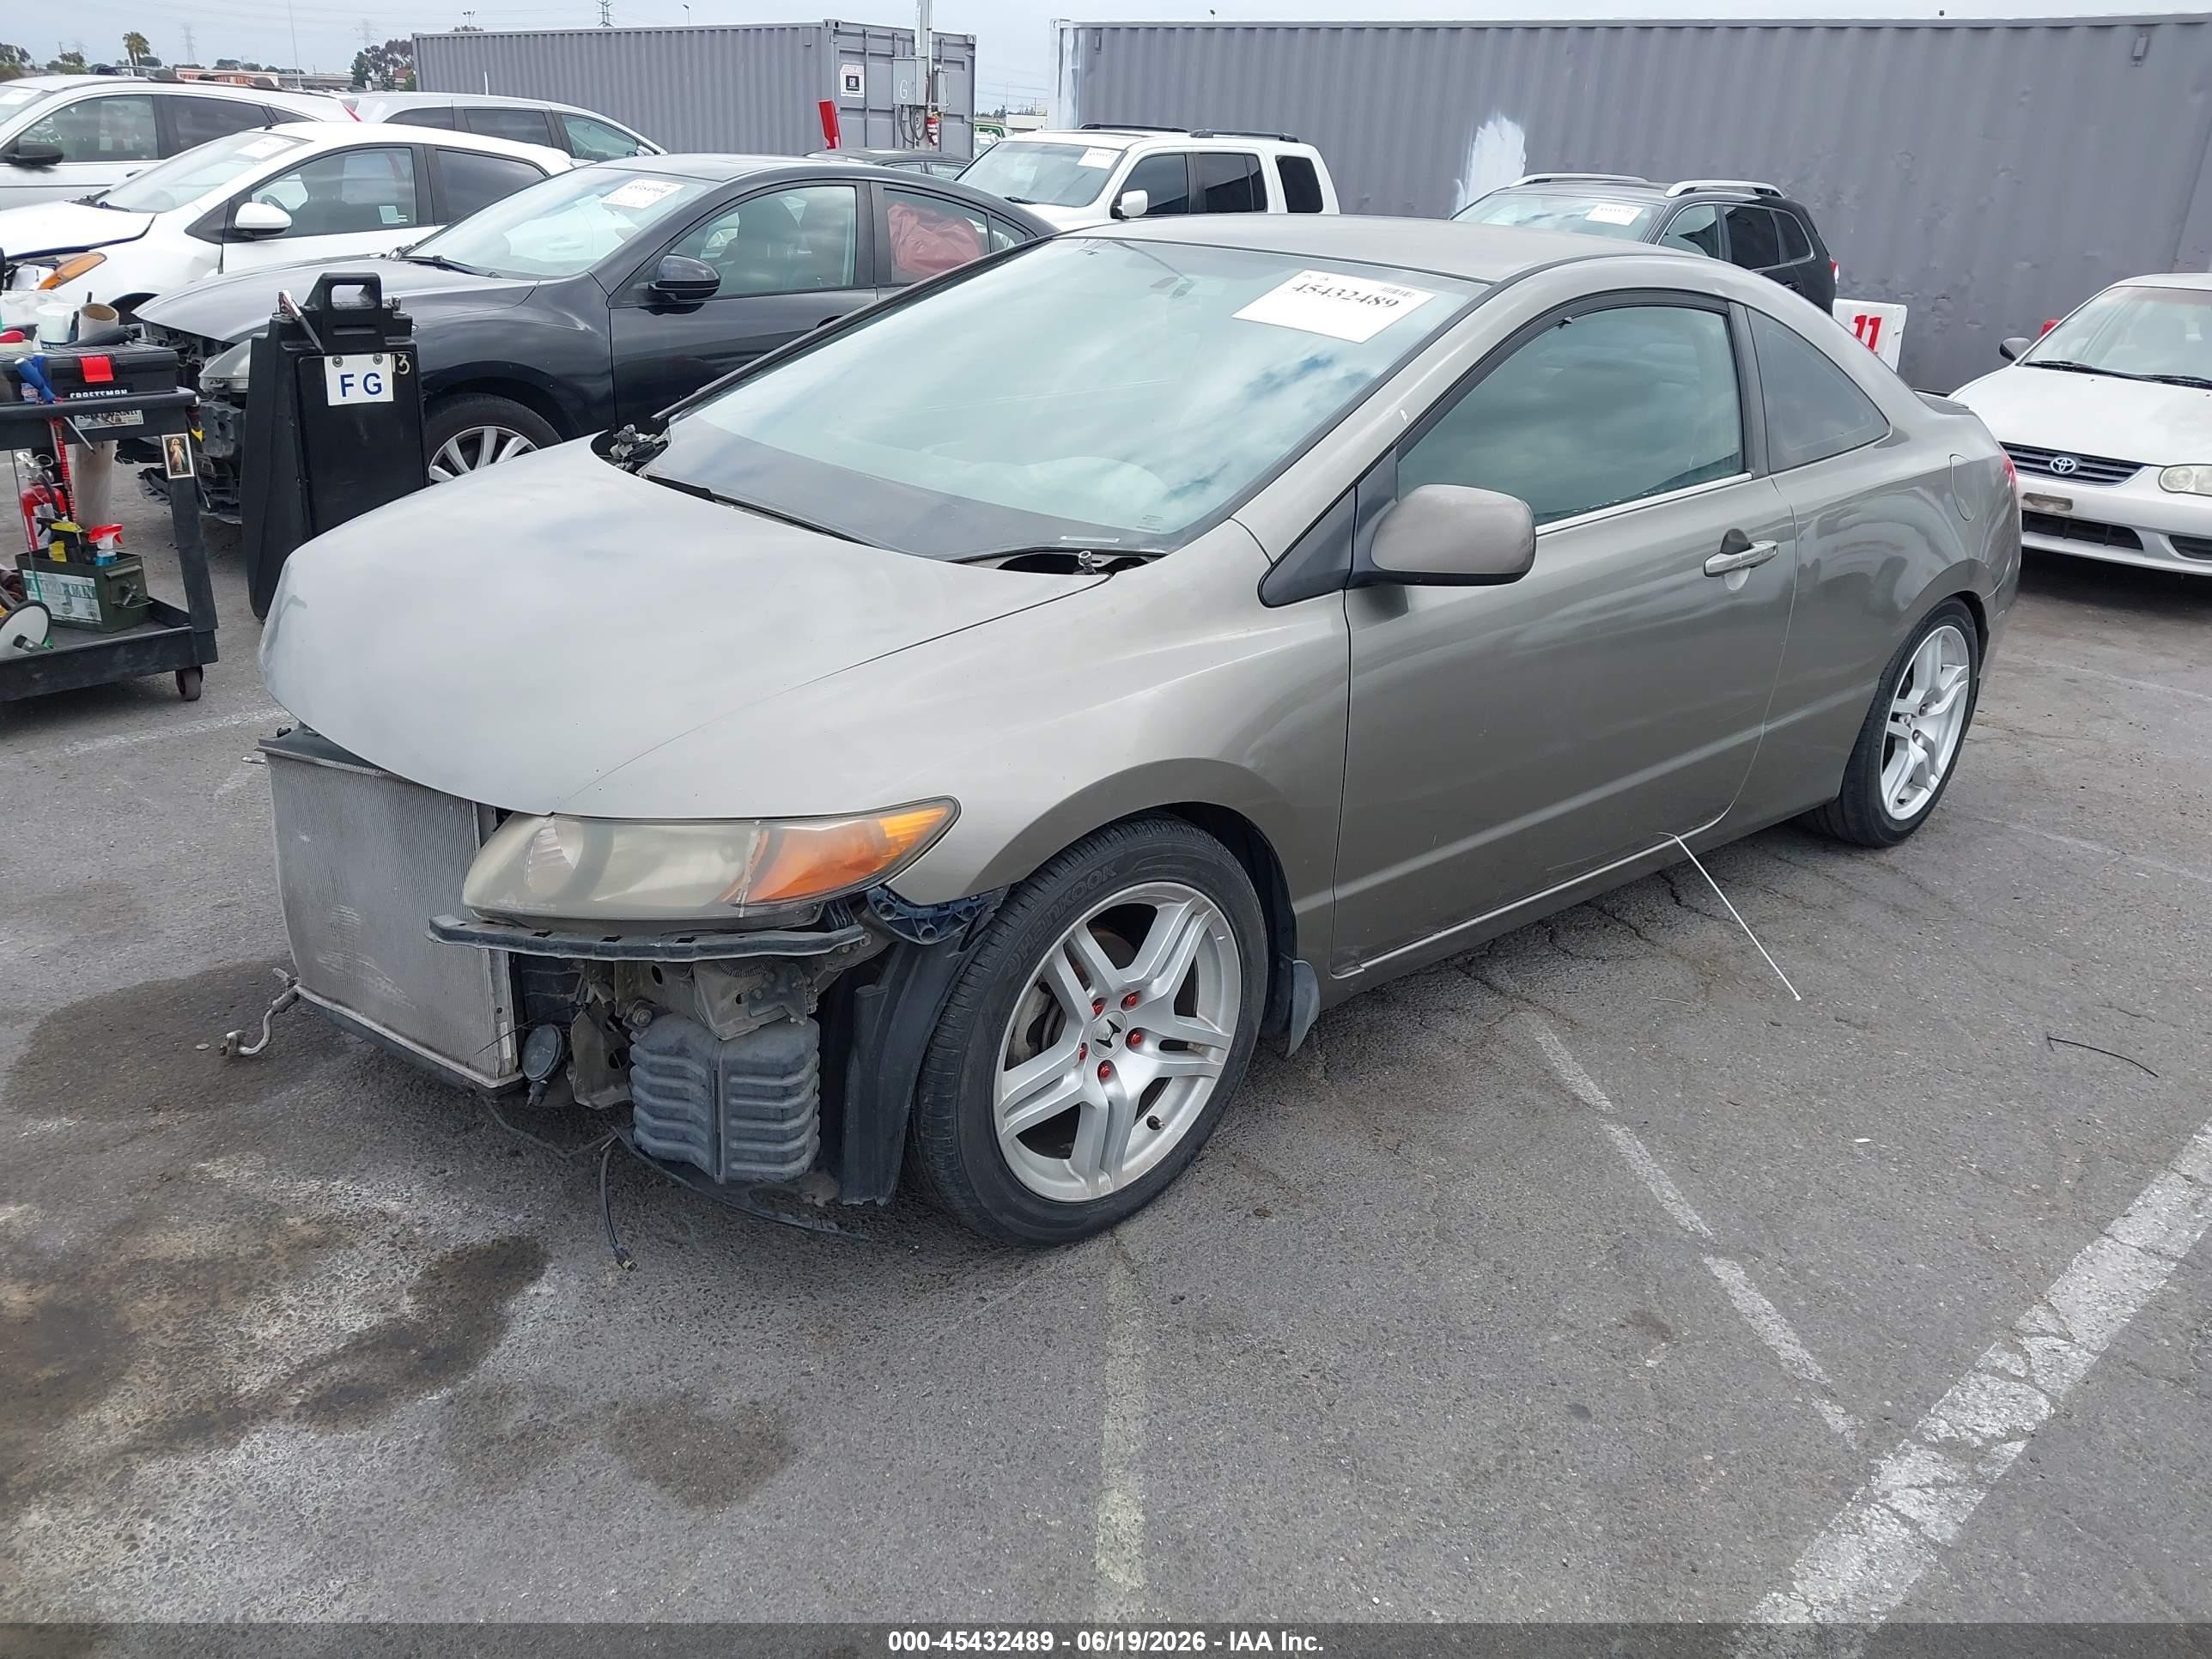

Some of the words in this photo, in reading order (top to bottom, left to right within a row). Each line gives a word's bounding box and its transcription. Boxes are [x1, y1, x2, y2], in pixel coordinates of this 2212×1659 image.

[899, 79, 908, 99] G
[1291, 283, 1399, 308] 45432489
[1854, 314, 1882, 351] 11
